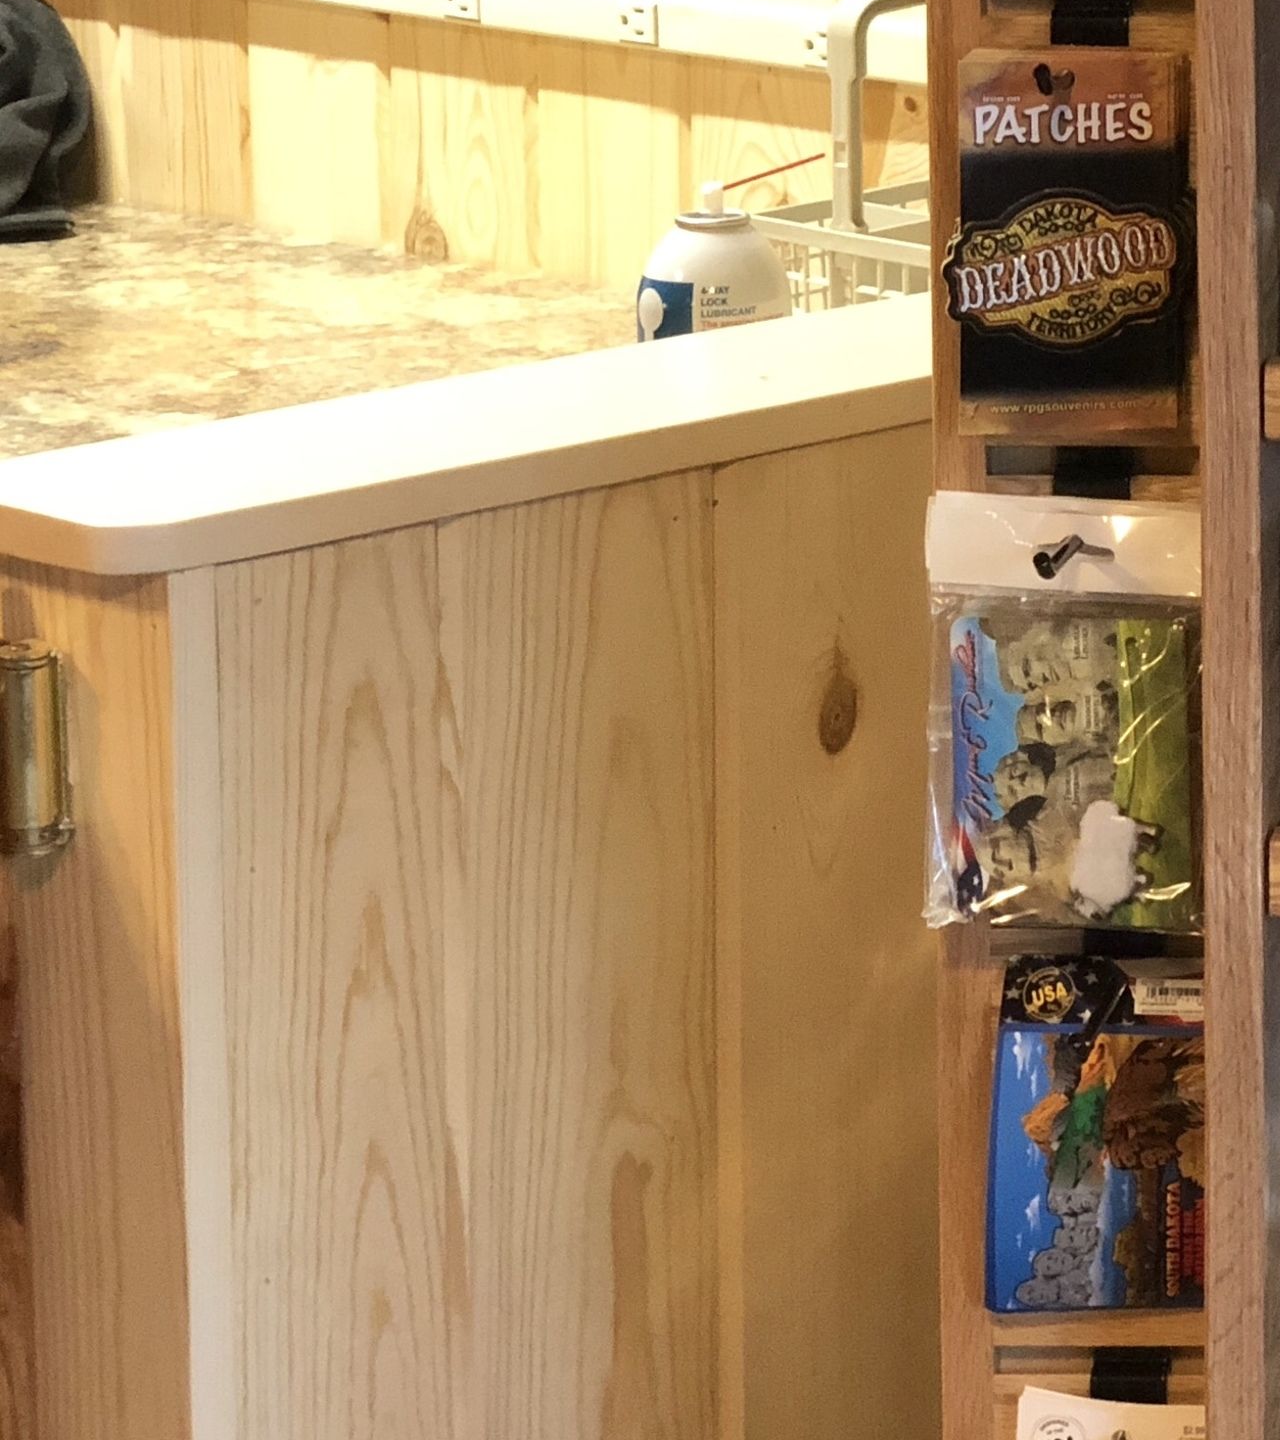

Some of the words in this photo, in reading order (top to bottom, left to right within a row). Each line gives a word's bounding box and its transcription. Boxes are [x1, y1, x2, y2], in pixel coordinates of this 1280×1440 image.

[974, 102, 1154, 146] PATCHES
[1018, 203, 1099, 236] DAKOTA
[956, 220, 1171, 313] DEADWOOD
[701, 297, 728, 306] LOCK
[701, 306, 757, 318] LUBRICANT
[1027, 303, 1116, 340] TERRITORY
[1031, 981, 1068, 1006] USA
[1165, 1181, 1181, 1249] DAKOTA
[1166, 1251, 1180, 1298] SOUTH
